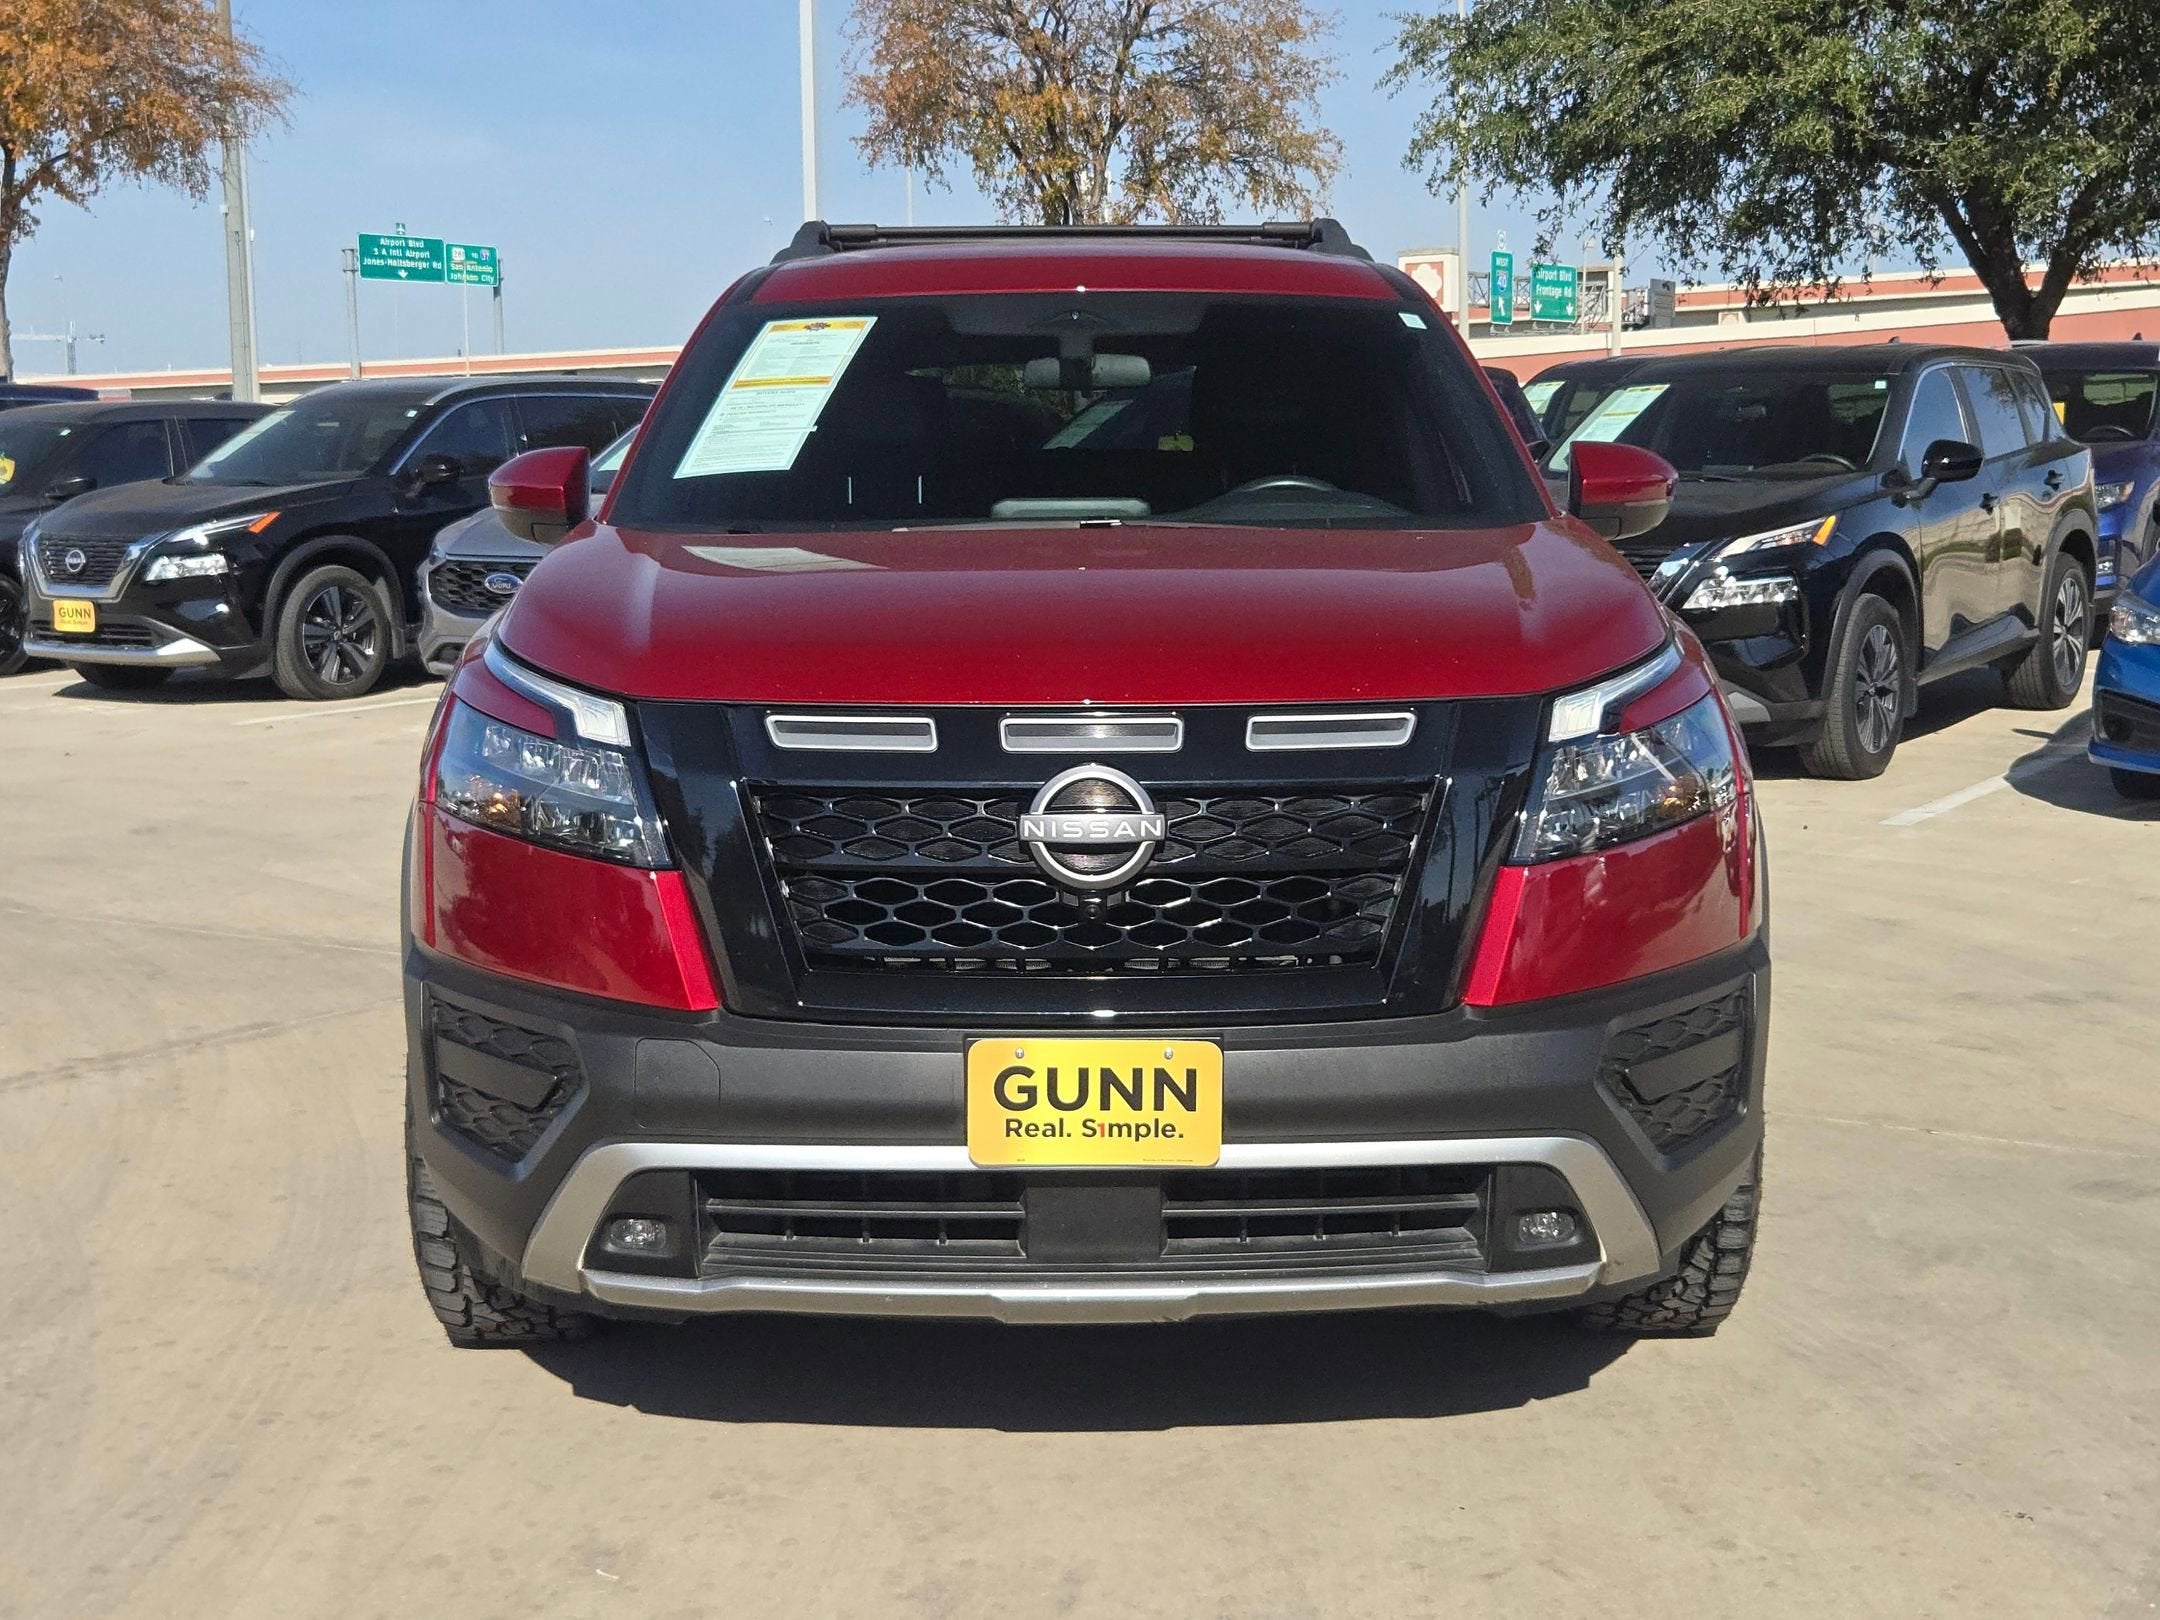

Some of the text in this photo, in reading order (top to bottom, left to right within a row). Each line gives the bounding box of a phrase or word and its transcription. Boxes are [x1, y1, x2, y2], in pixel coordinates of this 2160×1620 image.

[380, 237, 424, 248] Airport Blvd
[373, 247, 379, 256] S
[381, 248, 388, 256] A
[405, 250, 430, 259] Airport
[432, 261, 442, 270] Rd
[481, 274, 495, 285] City
[1559, 270, 1573, 282] Blvd
[1536, 284, 1572, 299] Frontage Rd
[58, 607, 91, 619] GUNN
[1023, 819, 1162, 838] NISSAN
[993, 1065, 1197, 1112] GUNN
[1005, 1117, 1072, 1138] Real.
